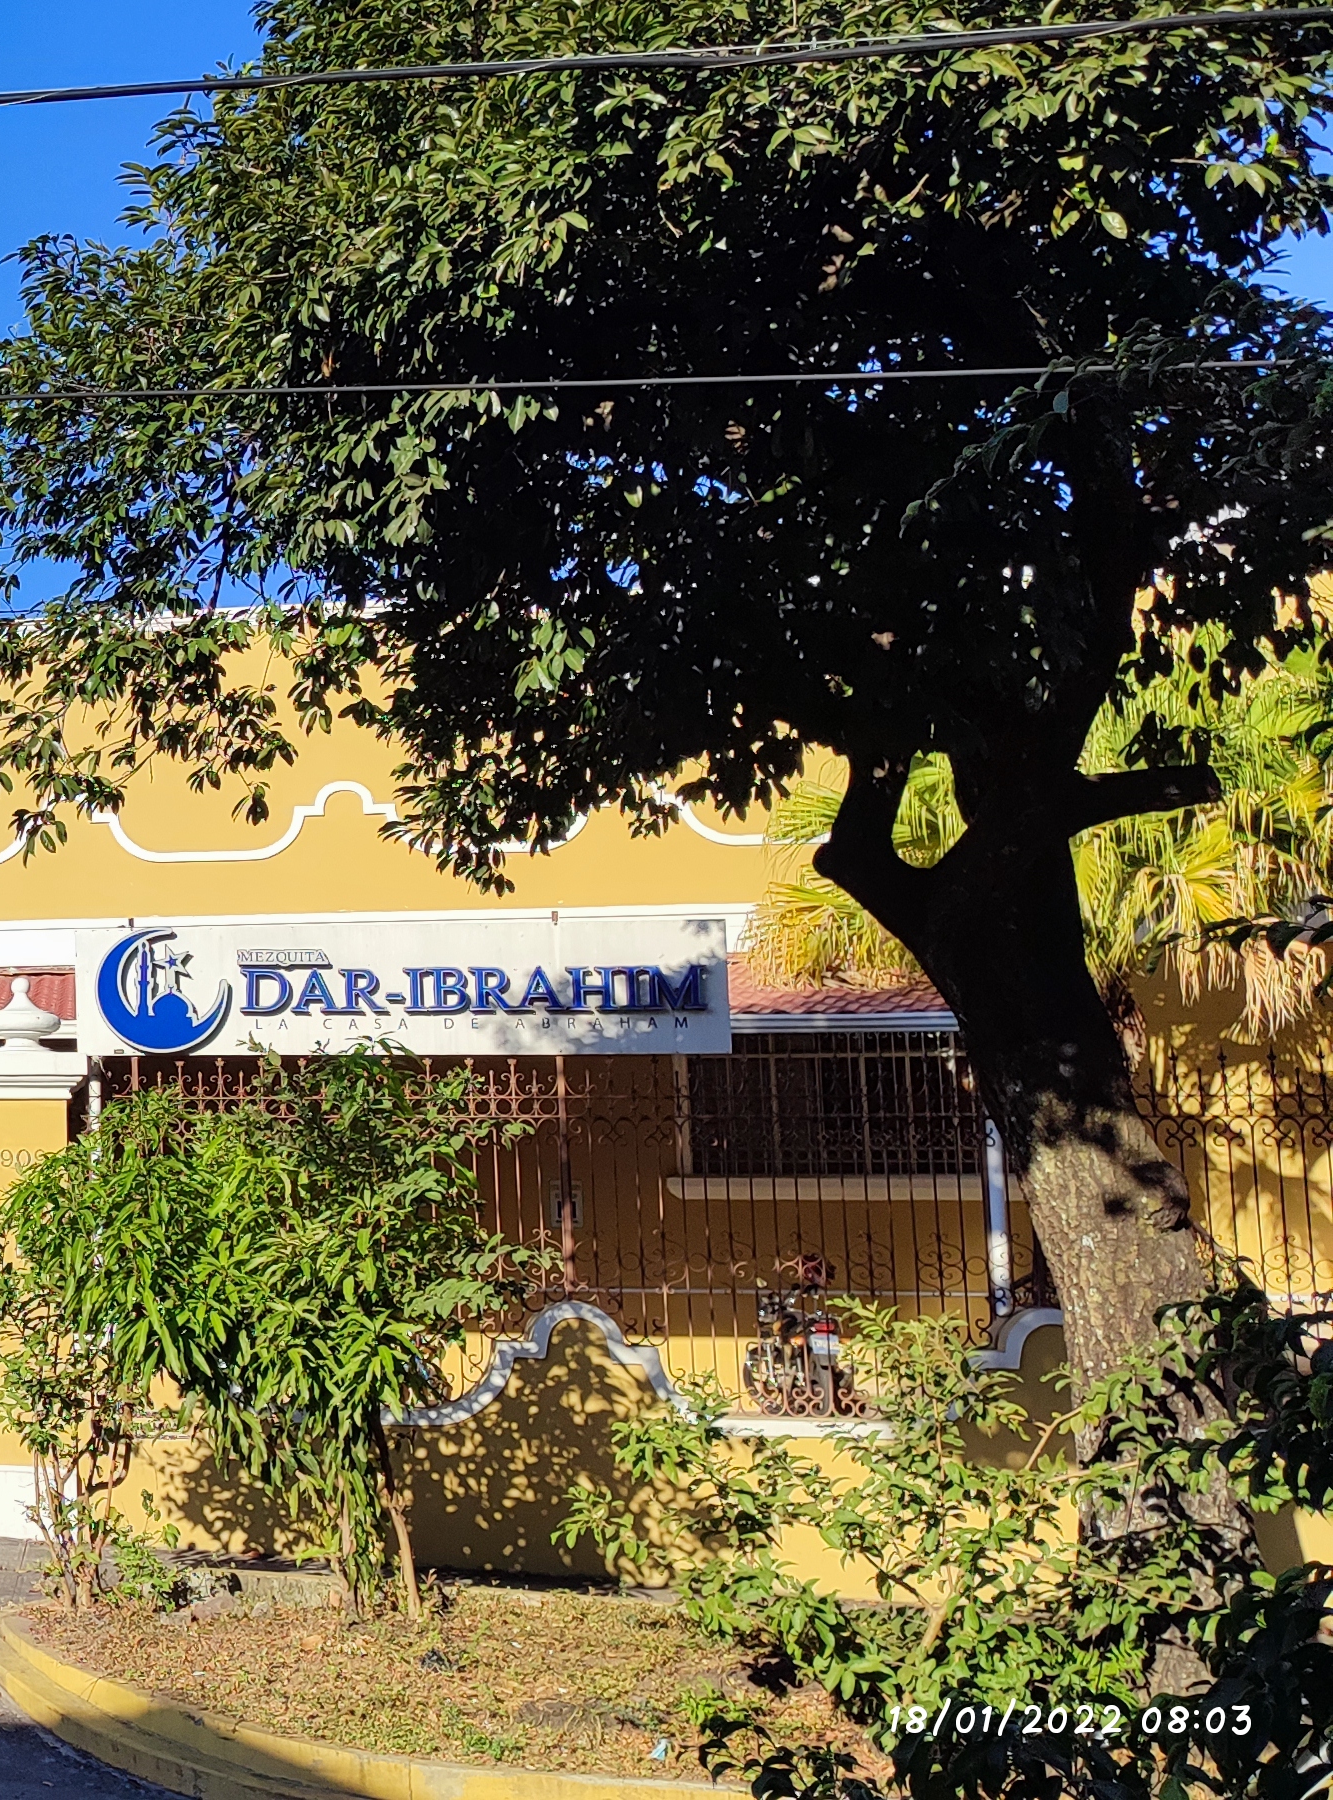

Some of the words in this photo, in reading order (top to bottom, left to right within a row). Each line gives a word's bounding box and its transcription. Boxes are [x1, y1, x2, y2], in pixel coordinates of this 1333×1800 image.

[240, 951, 326, 965] MEZQUITA
[240, 966, 709, 1014] DAR-IBRAHIM
[255, 1018, 289, 1030] LA
[323, 1018, 409, 1030] CASA
[444, 1018, 479, 1030] DE
[515, 1017, 689, 1030] ABRAHAM
